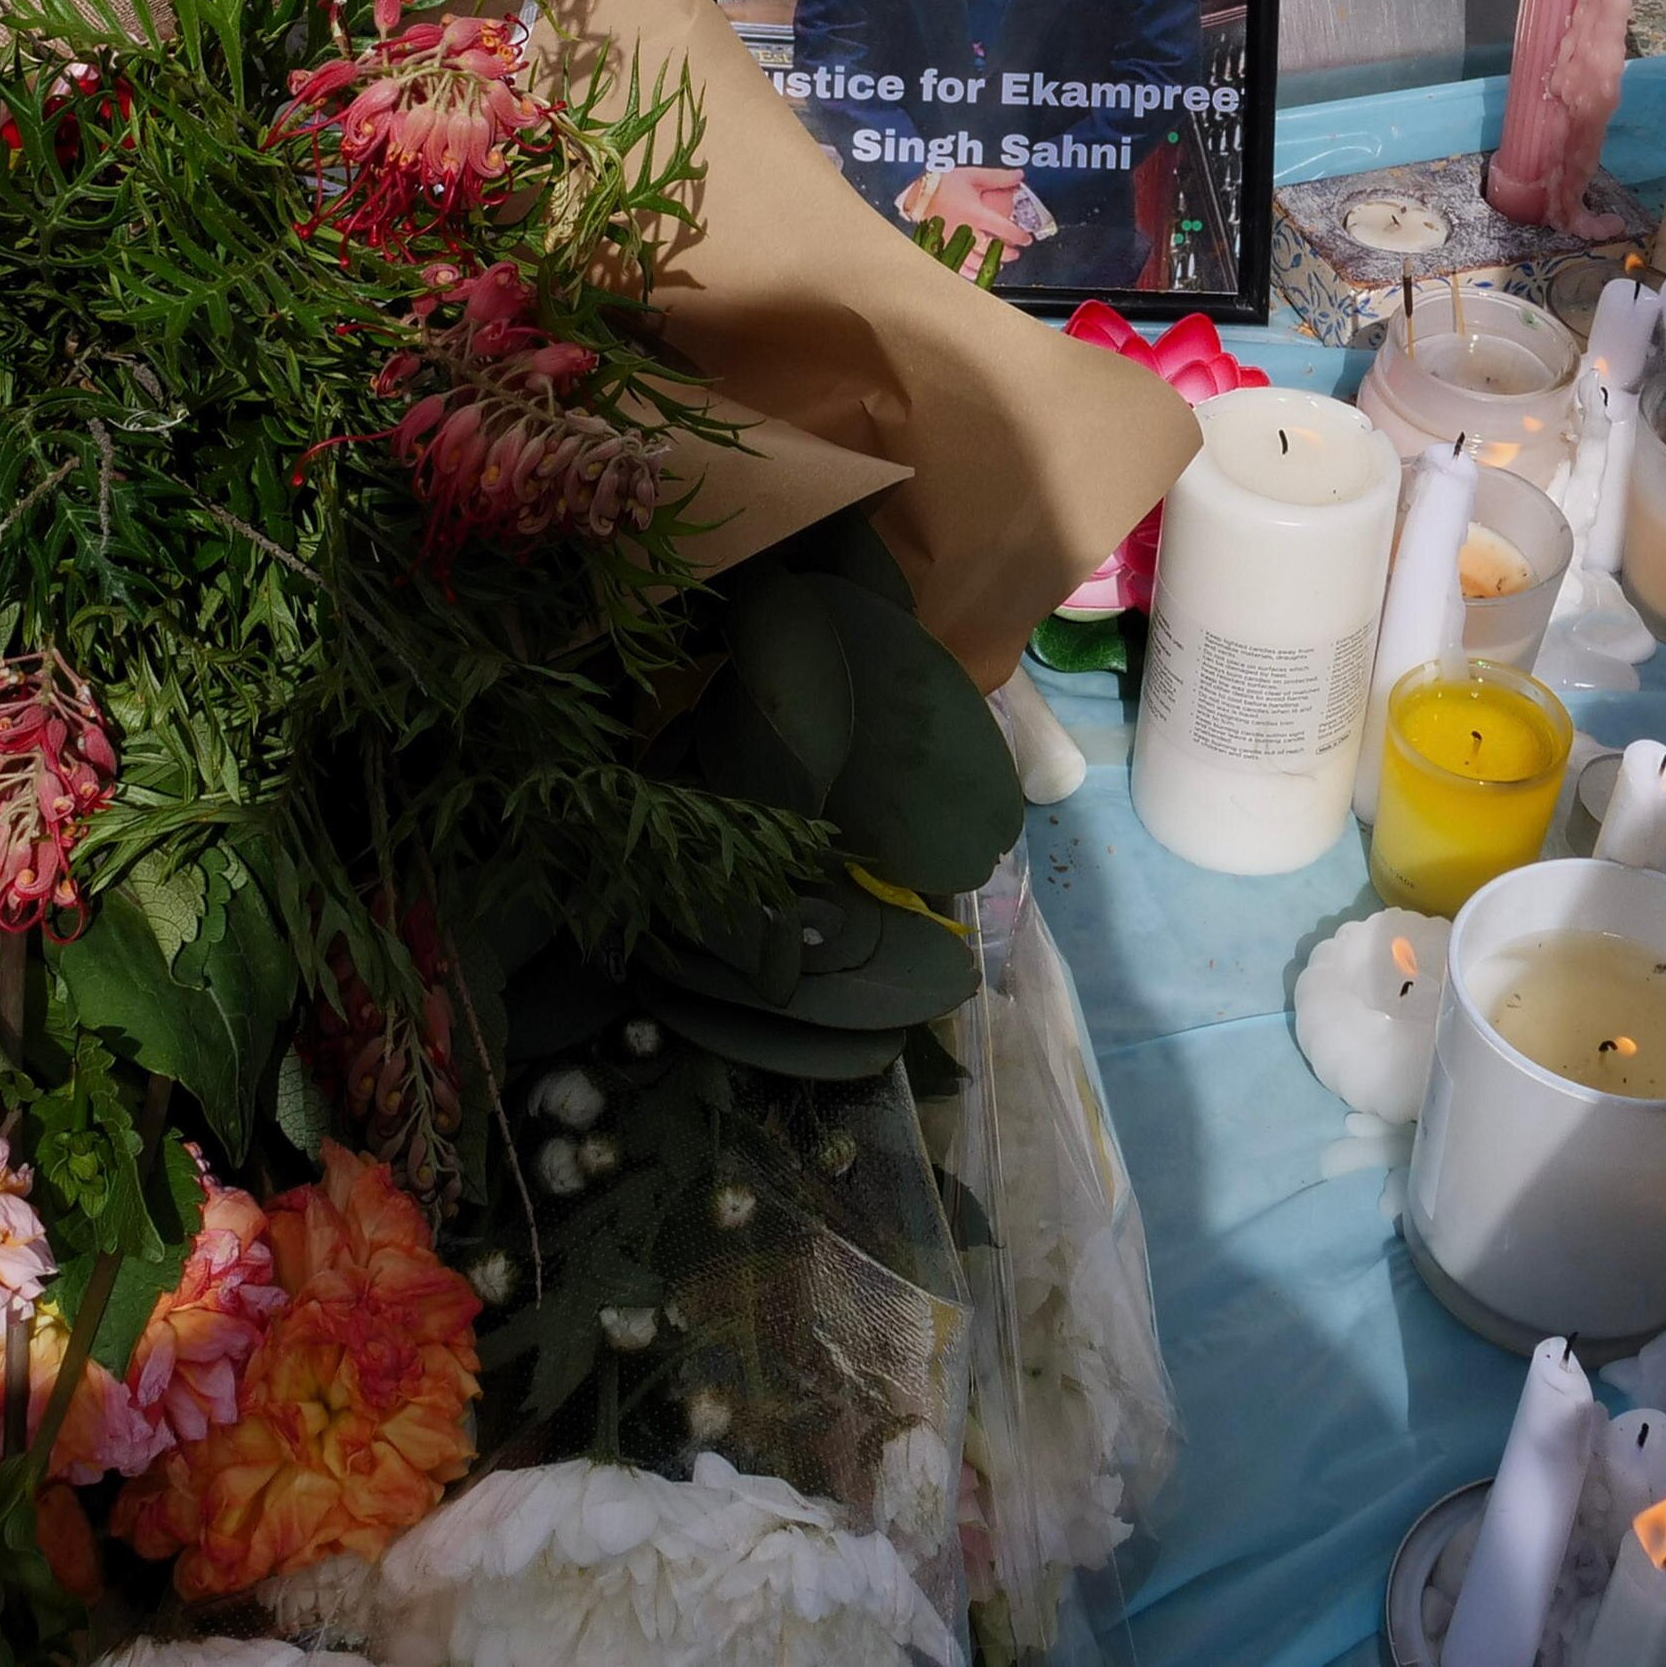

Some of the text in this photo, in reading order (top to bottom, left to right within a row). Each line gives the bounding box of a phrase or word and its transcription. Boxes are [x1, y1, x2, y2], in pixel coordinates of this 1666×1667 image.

[764, 64, 1246, 117] stice for Ekampree
[851, 128, 1132, 173] Singh Sahni
